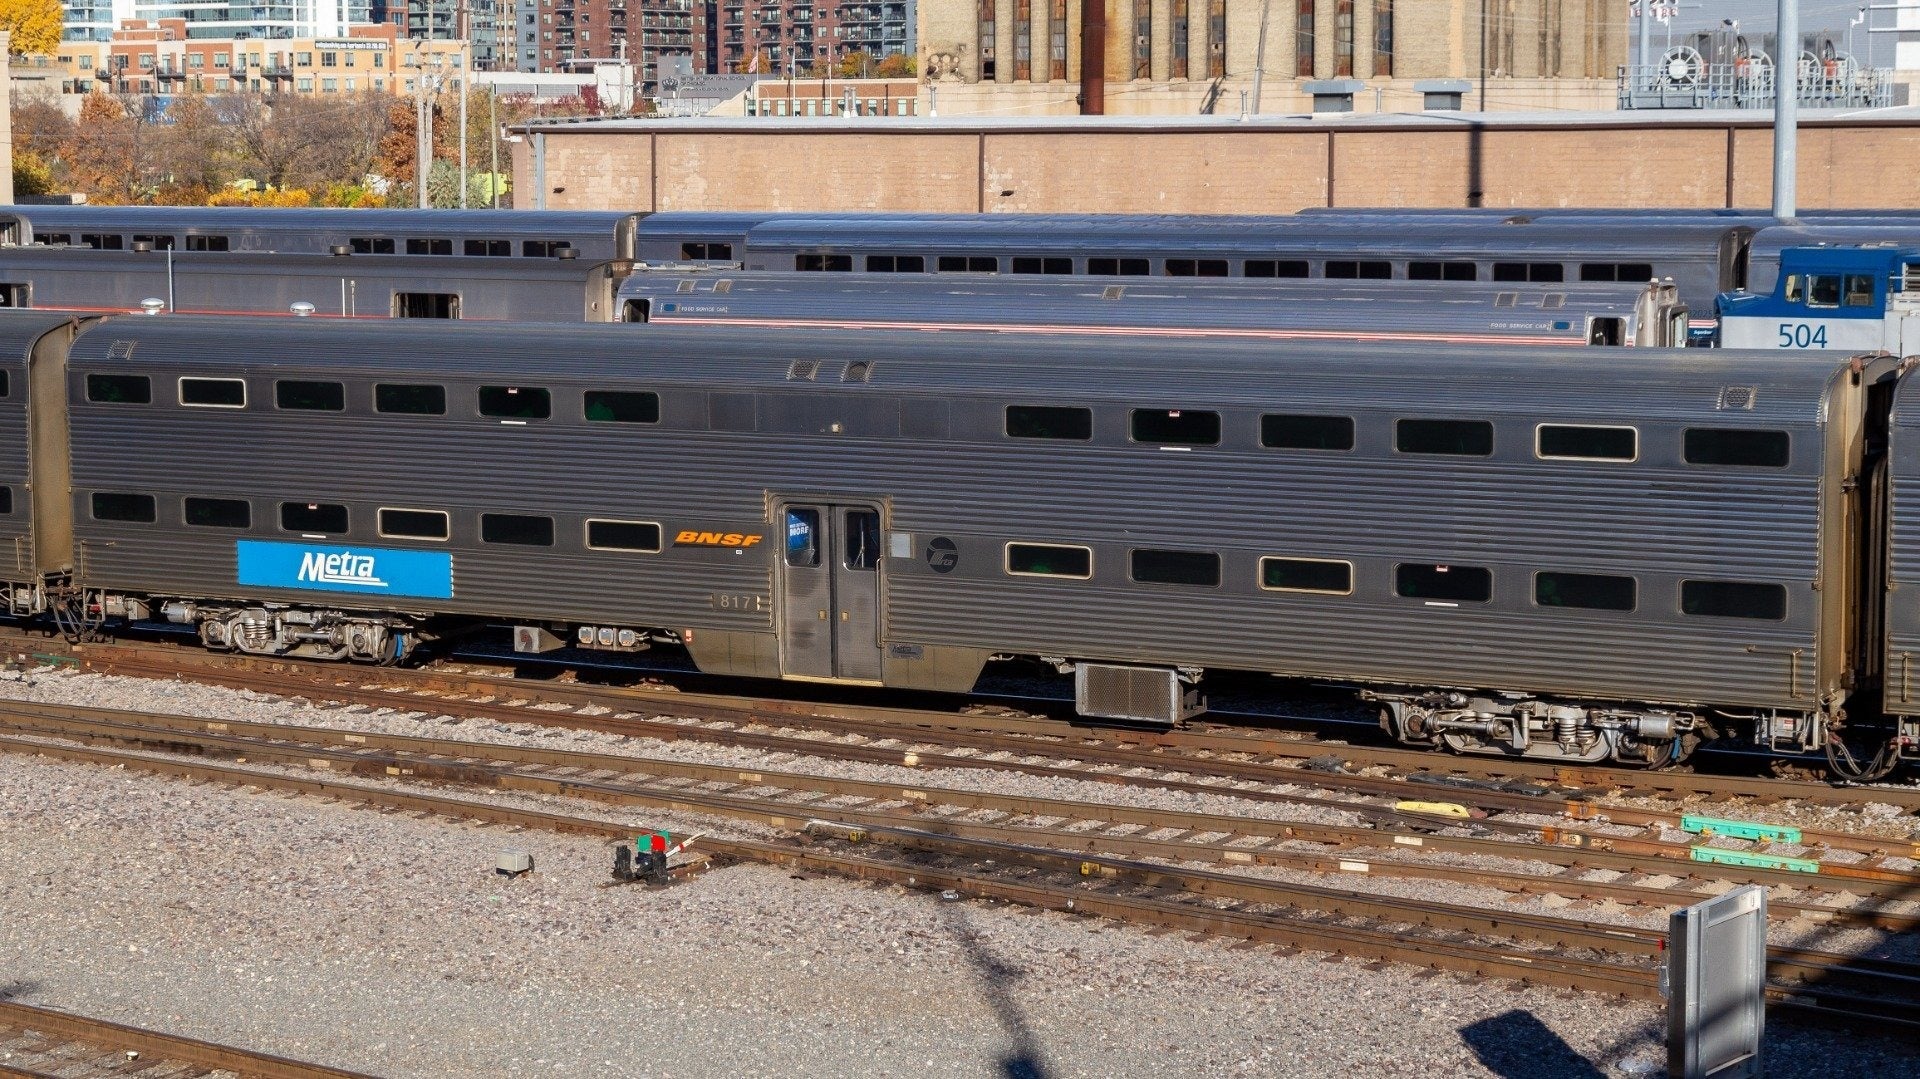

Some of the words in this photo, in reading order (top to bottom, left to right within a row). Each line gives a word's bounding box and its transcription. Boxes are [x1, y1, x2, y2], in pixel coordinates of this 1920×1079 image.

[1778, 323, 1828, 348] 504
[674, 530, 763, 548] BNSF
[297, 551, 378, 583] Metra
[720, 594, 751, 609] 817
